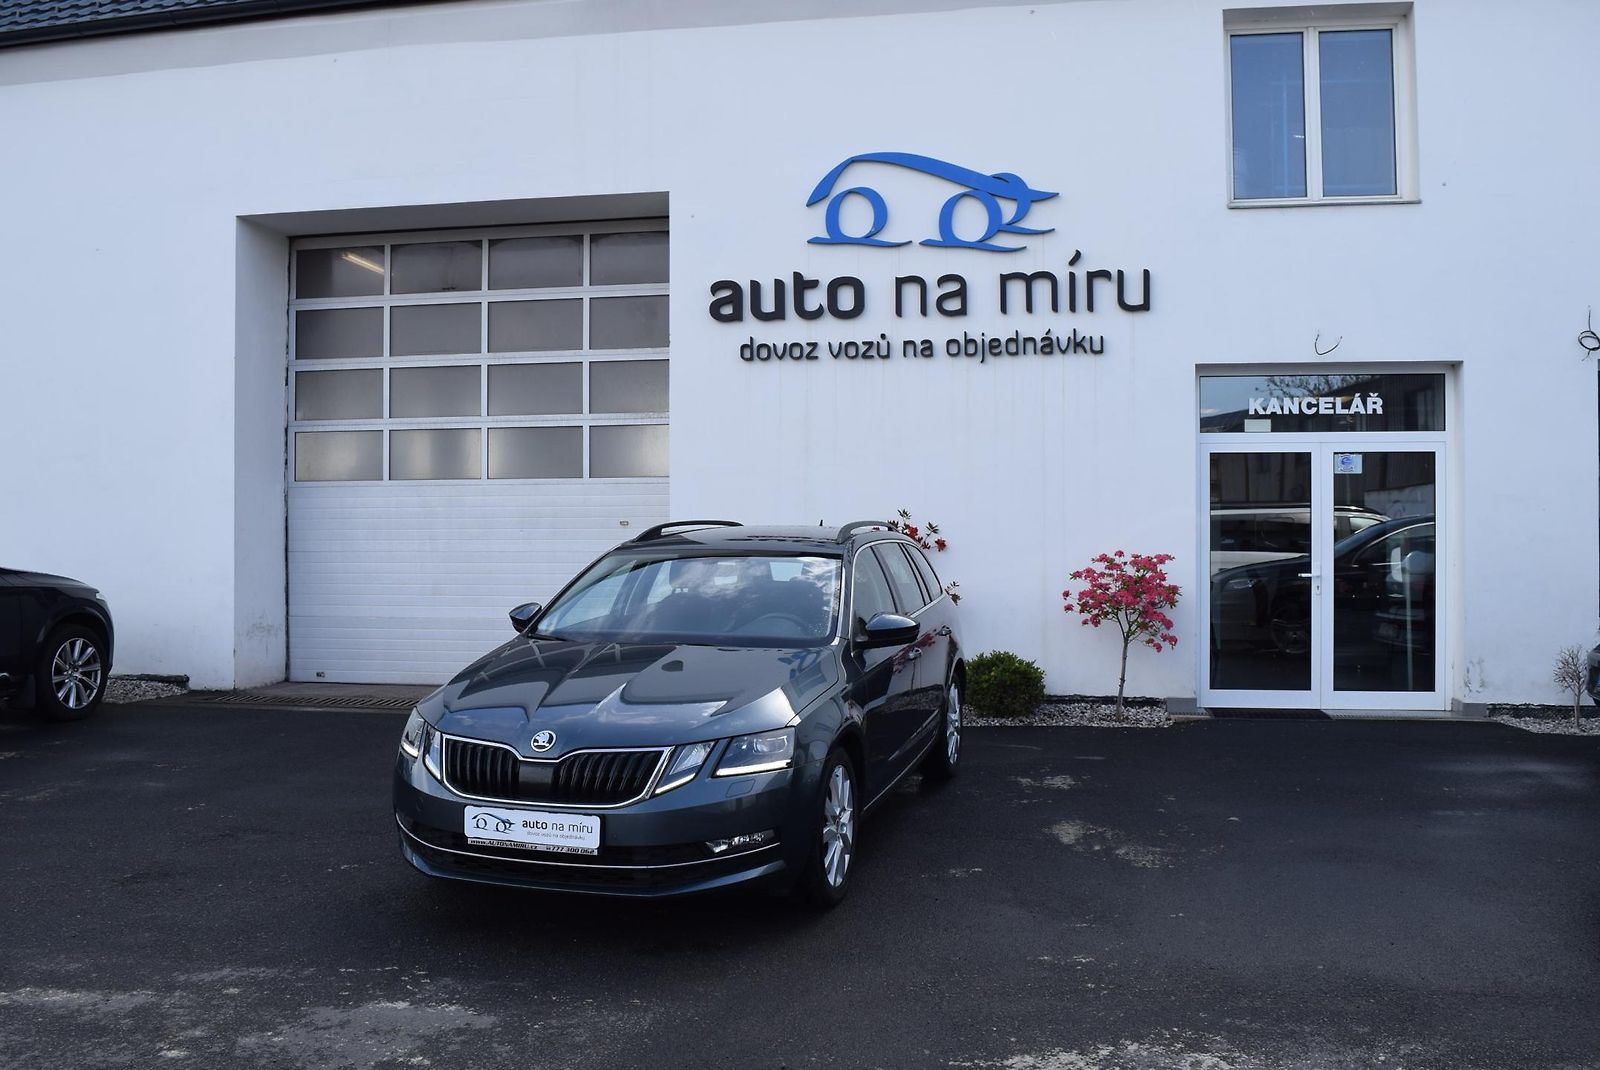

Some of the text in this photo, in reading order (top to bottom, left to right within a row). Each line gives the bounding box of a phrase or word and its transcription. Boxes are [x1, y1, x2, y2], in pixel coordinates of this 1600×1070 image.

[708, 249, 1151, 323] auto na míru
[739, 328, 1105, 364] dovoz vozů na objednávku
[1249, 392, 1384, 415] KANCELÁŘ
[522, 819, 593, 834] auto na míru
